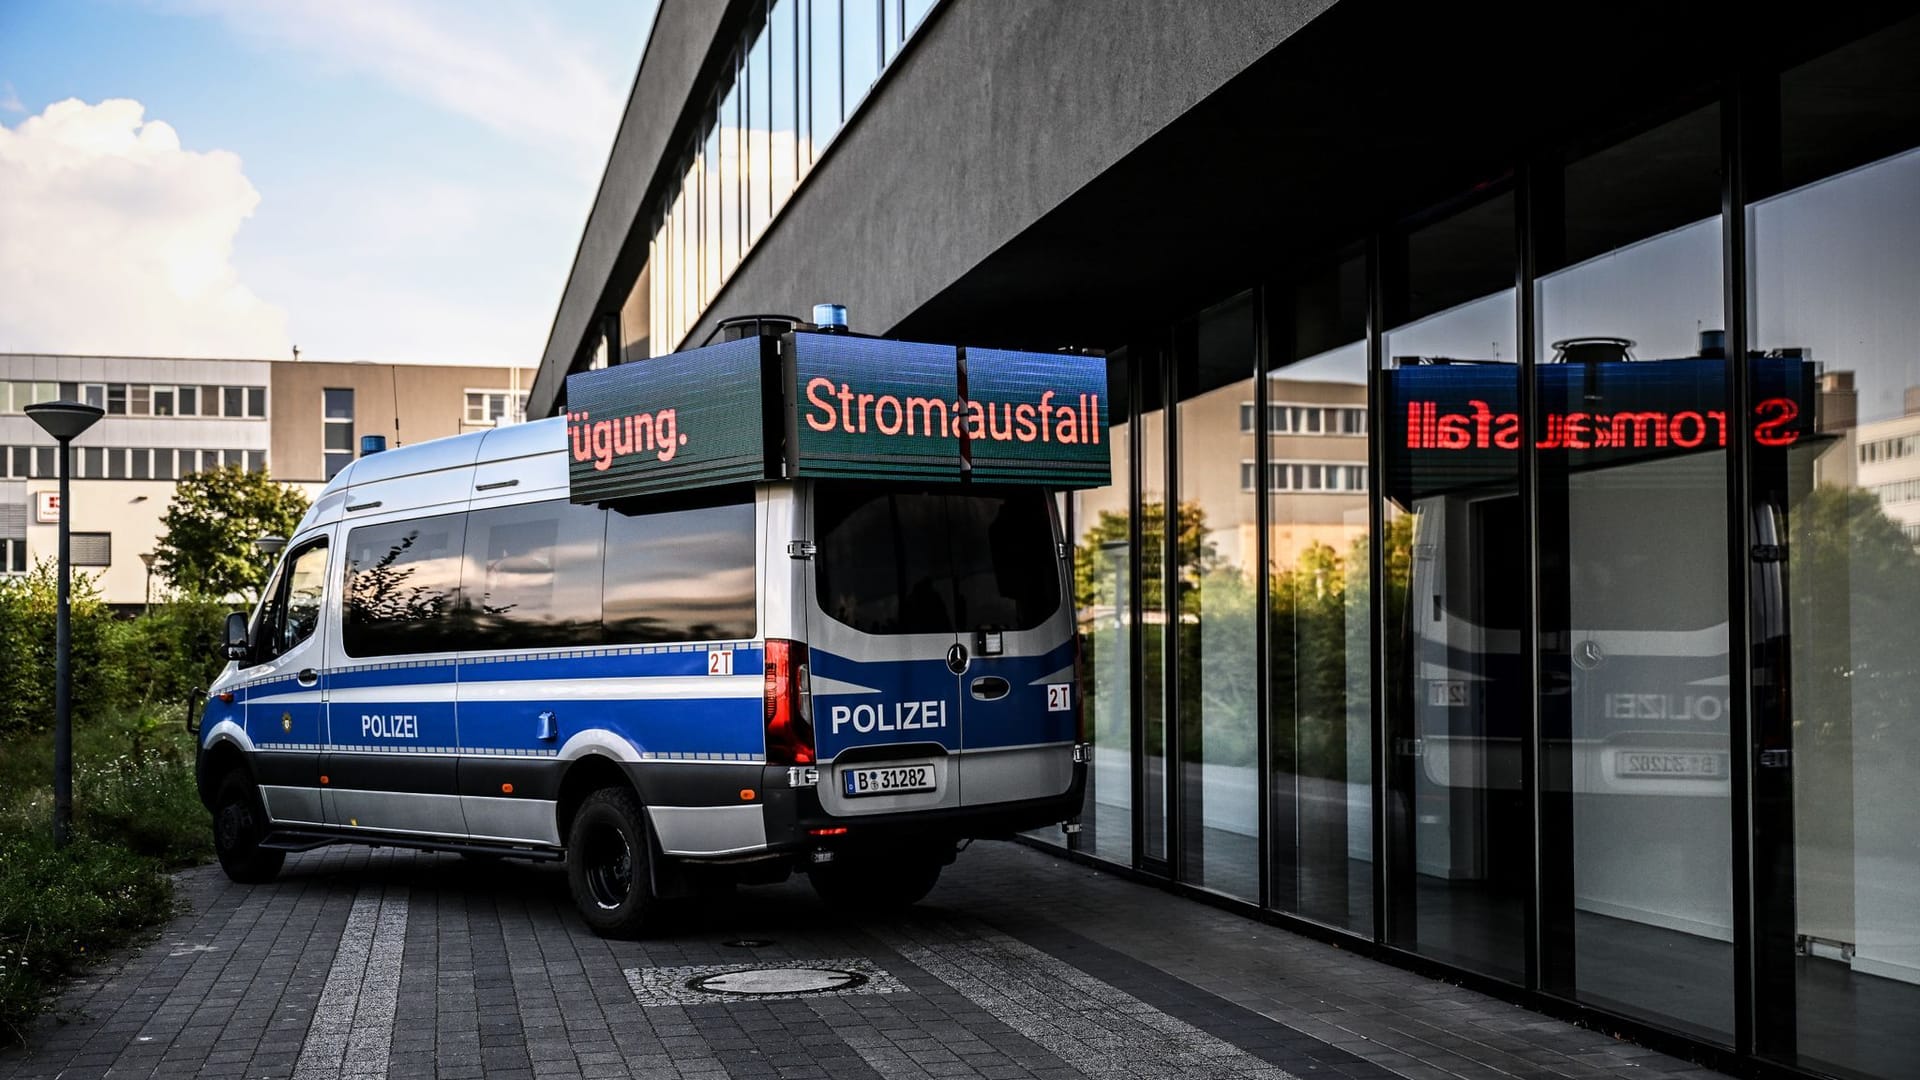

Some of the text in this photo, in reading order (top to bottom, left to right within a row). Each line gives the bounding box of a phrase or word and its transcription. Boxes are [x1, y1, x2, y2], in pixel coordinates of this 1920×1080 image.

[806, 377, 1100, 444] Stromausfall
[361, 715, 418, 738] POLIZEI
[832, 700, 946, 734] POLIZEI
[858, 772, 868, 790] B
[881, 768, 927, 789] 31282
